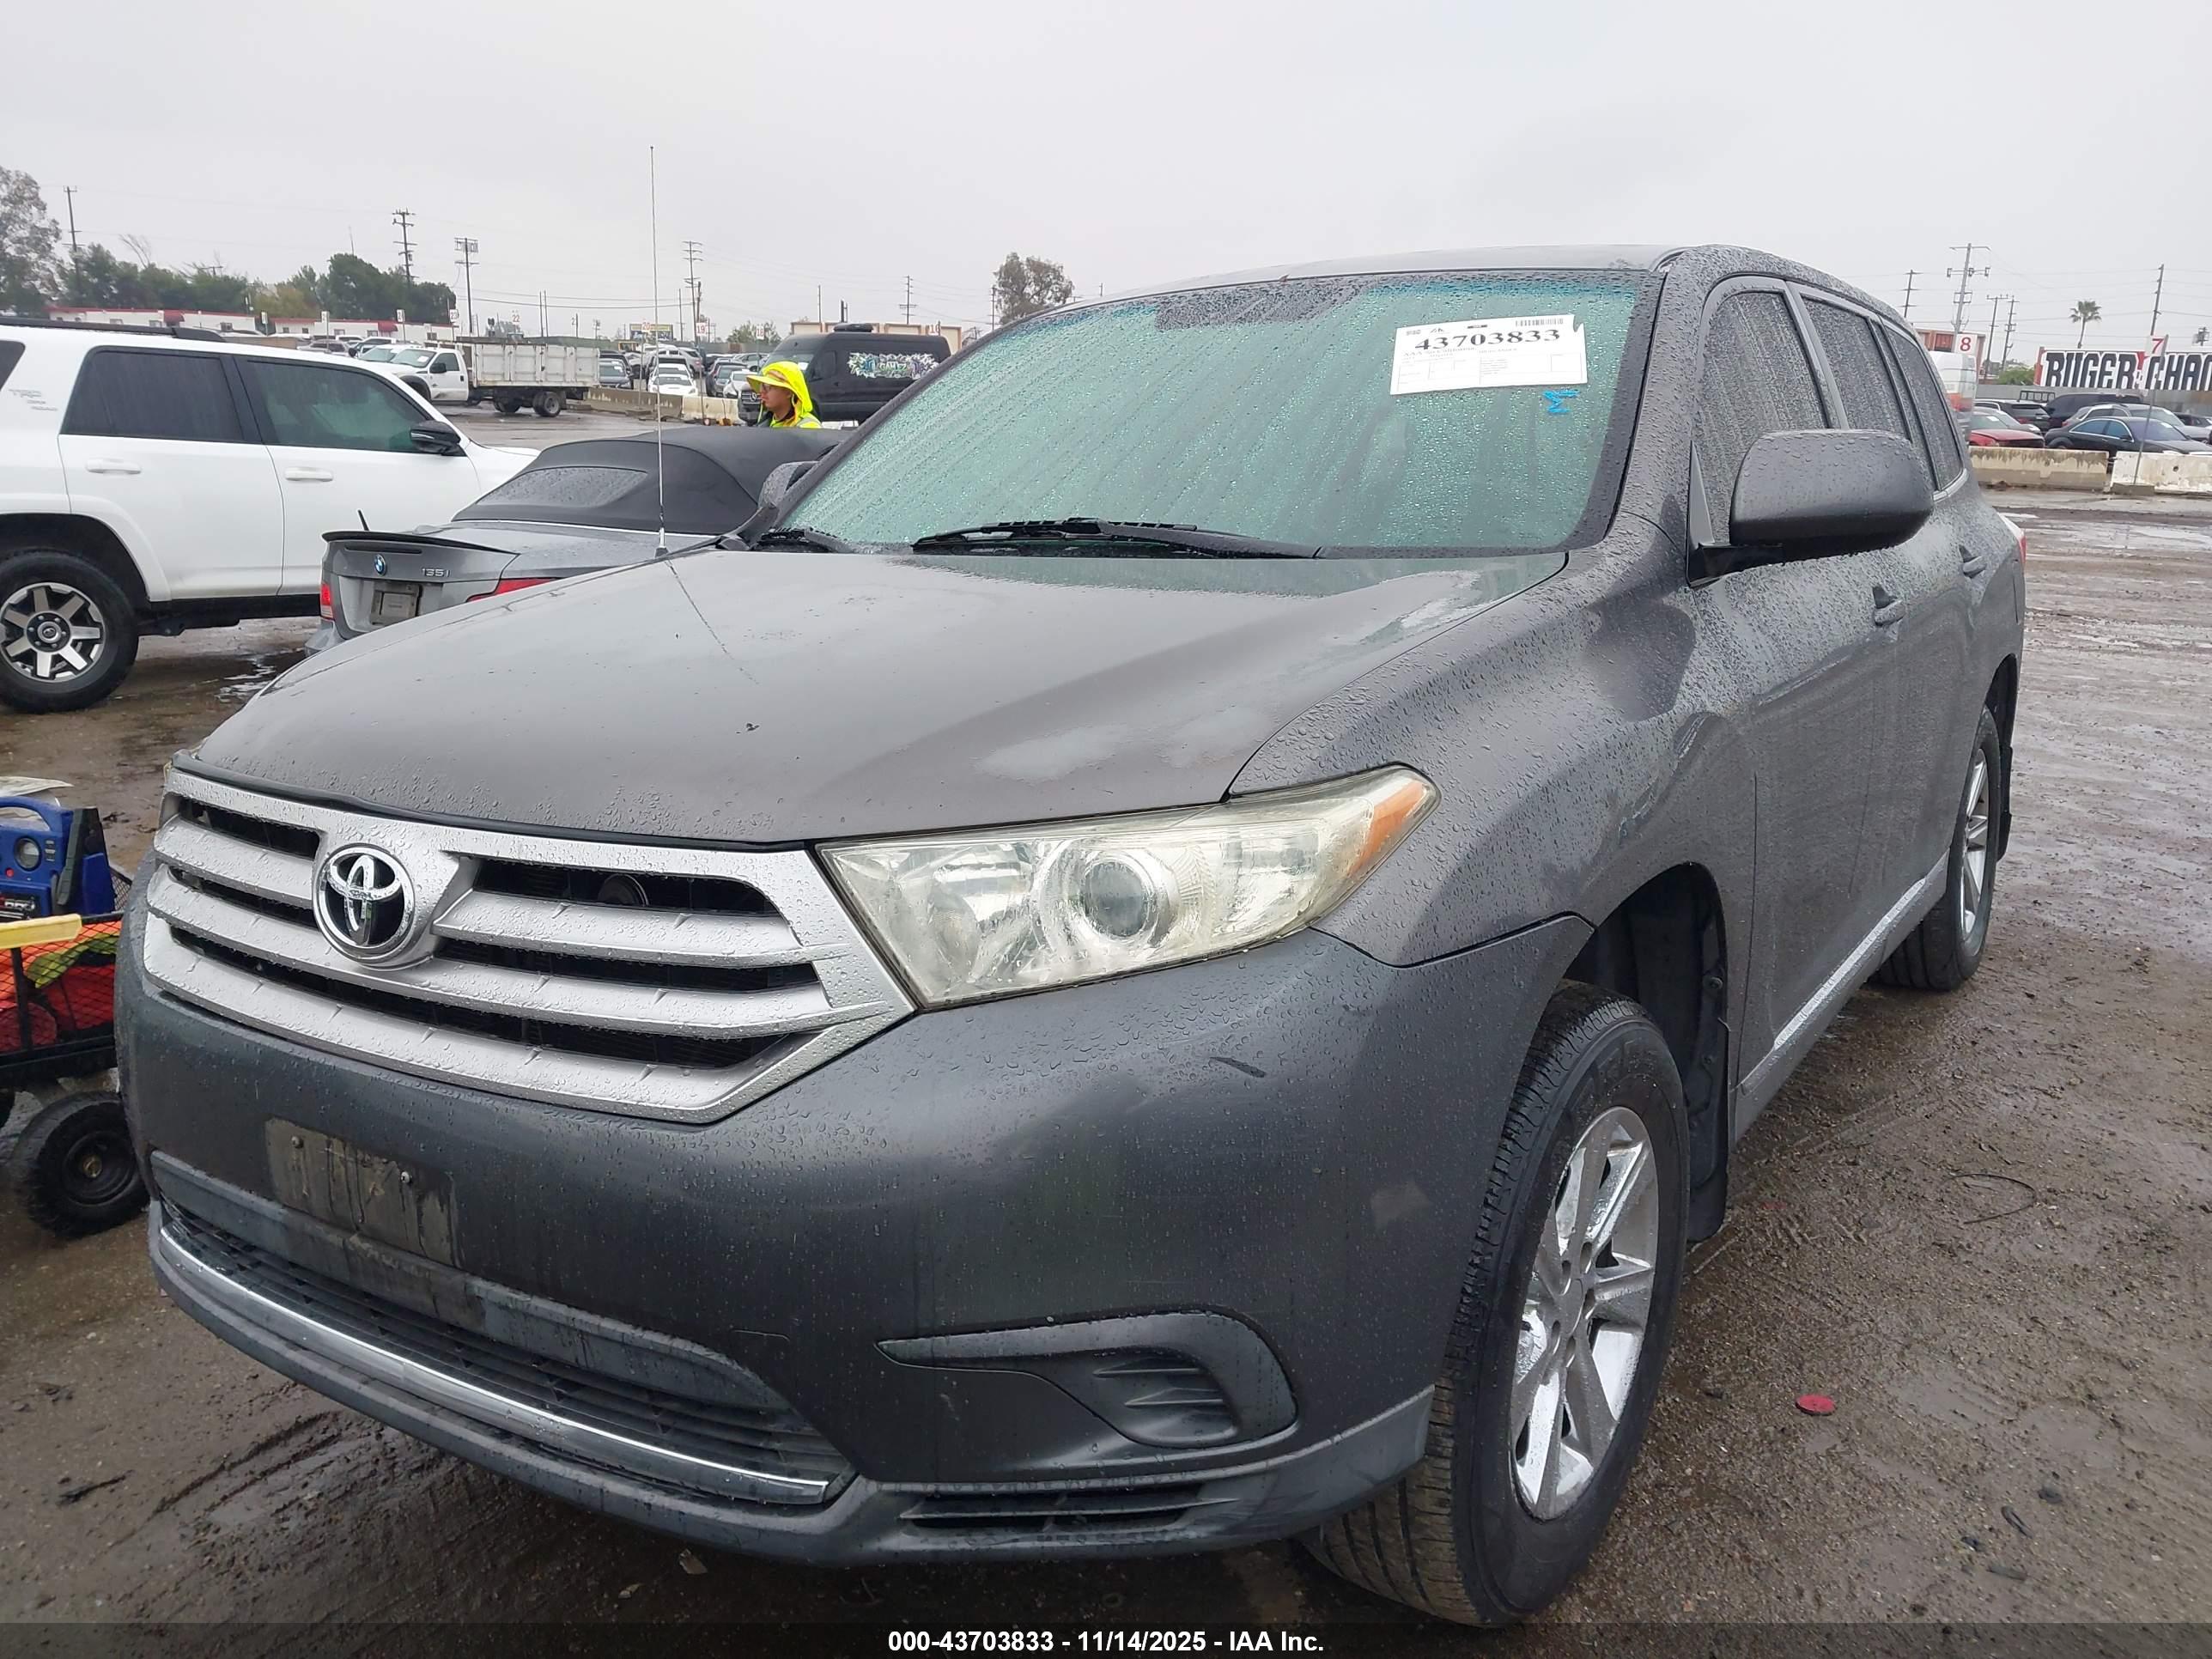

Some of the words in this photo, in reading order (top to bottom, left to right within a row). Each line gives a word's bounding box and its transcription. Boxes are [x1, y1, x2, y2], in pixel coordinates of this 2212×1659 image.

[642, 321, 651, 331] 20
[696, 325, 706, 334] 19
[1414, 329, 1560, 350] 43703833
[1960, 337, 1972, 352] 8
[2151, 337, 2165, 355] 7
